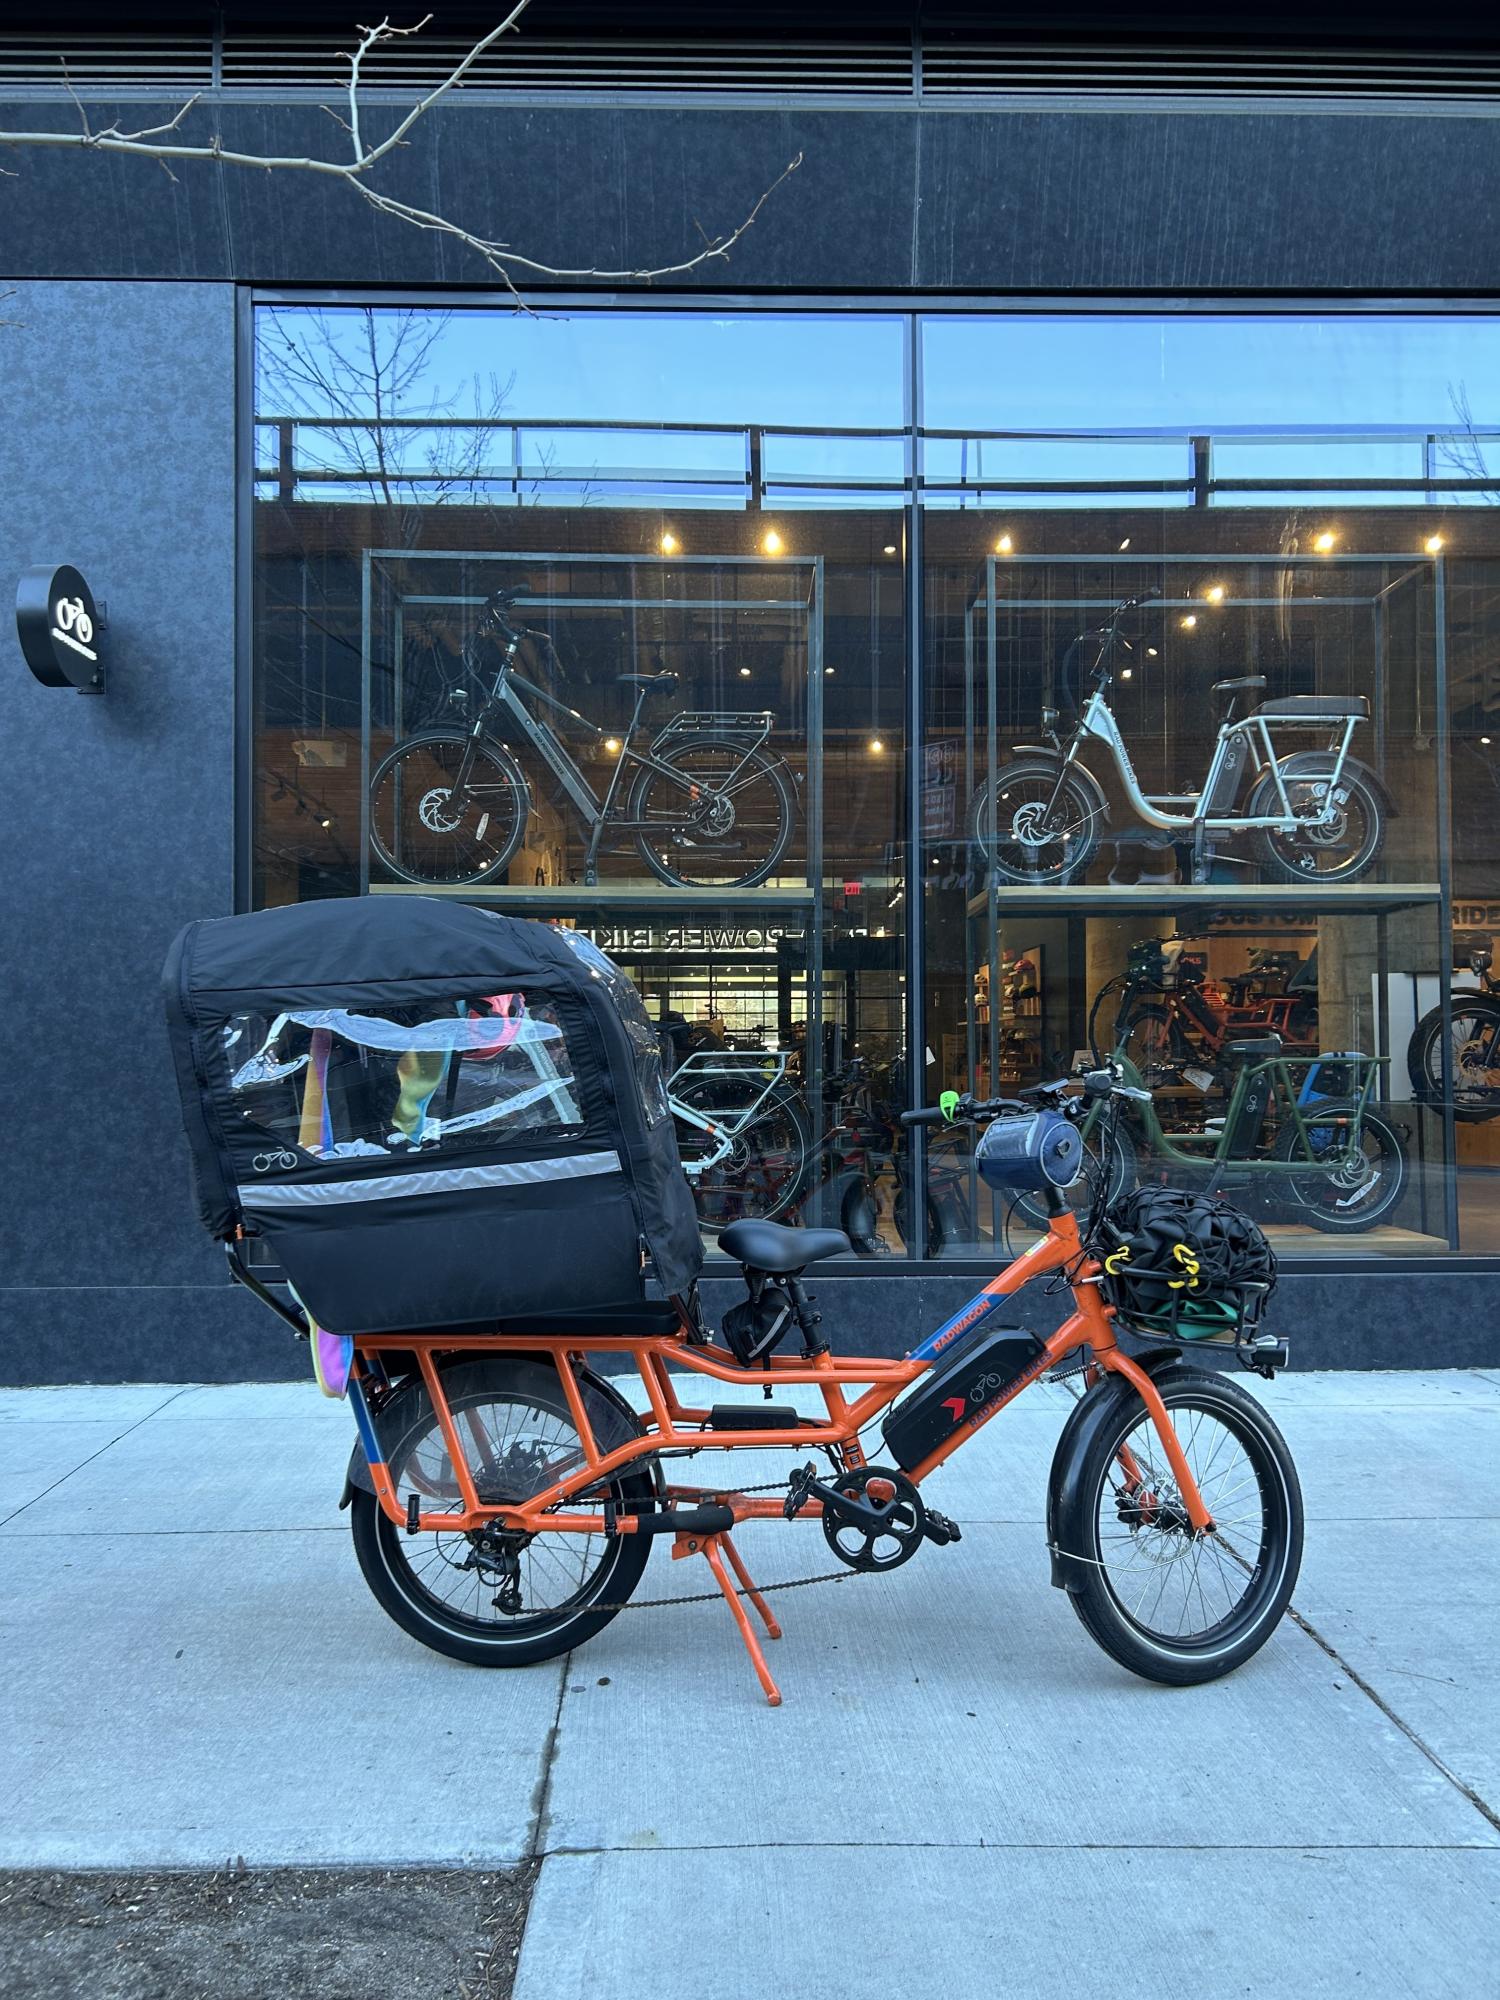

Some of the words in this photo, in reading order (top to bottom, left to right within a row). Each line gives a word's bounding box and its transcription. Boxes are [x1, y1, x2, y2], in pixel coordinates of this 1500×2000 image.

[932, 1299, 991, 1352] RADWAGON
[968, 1408, 990, 1428] RAD
[990, 1376, 1025, 1408] POWER
[1025, 1351, 1053, 1377] BIKES
